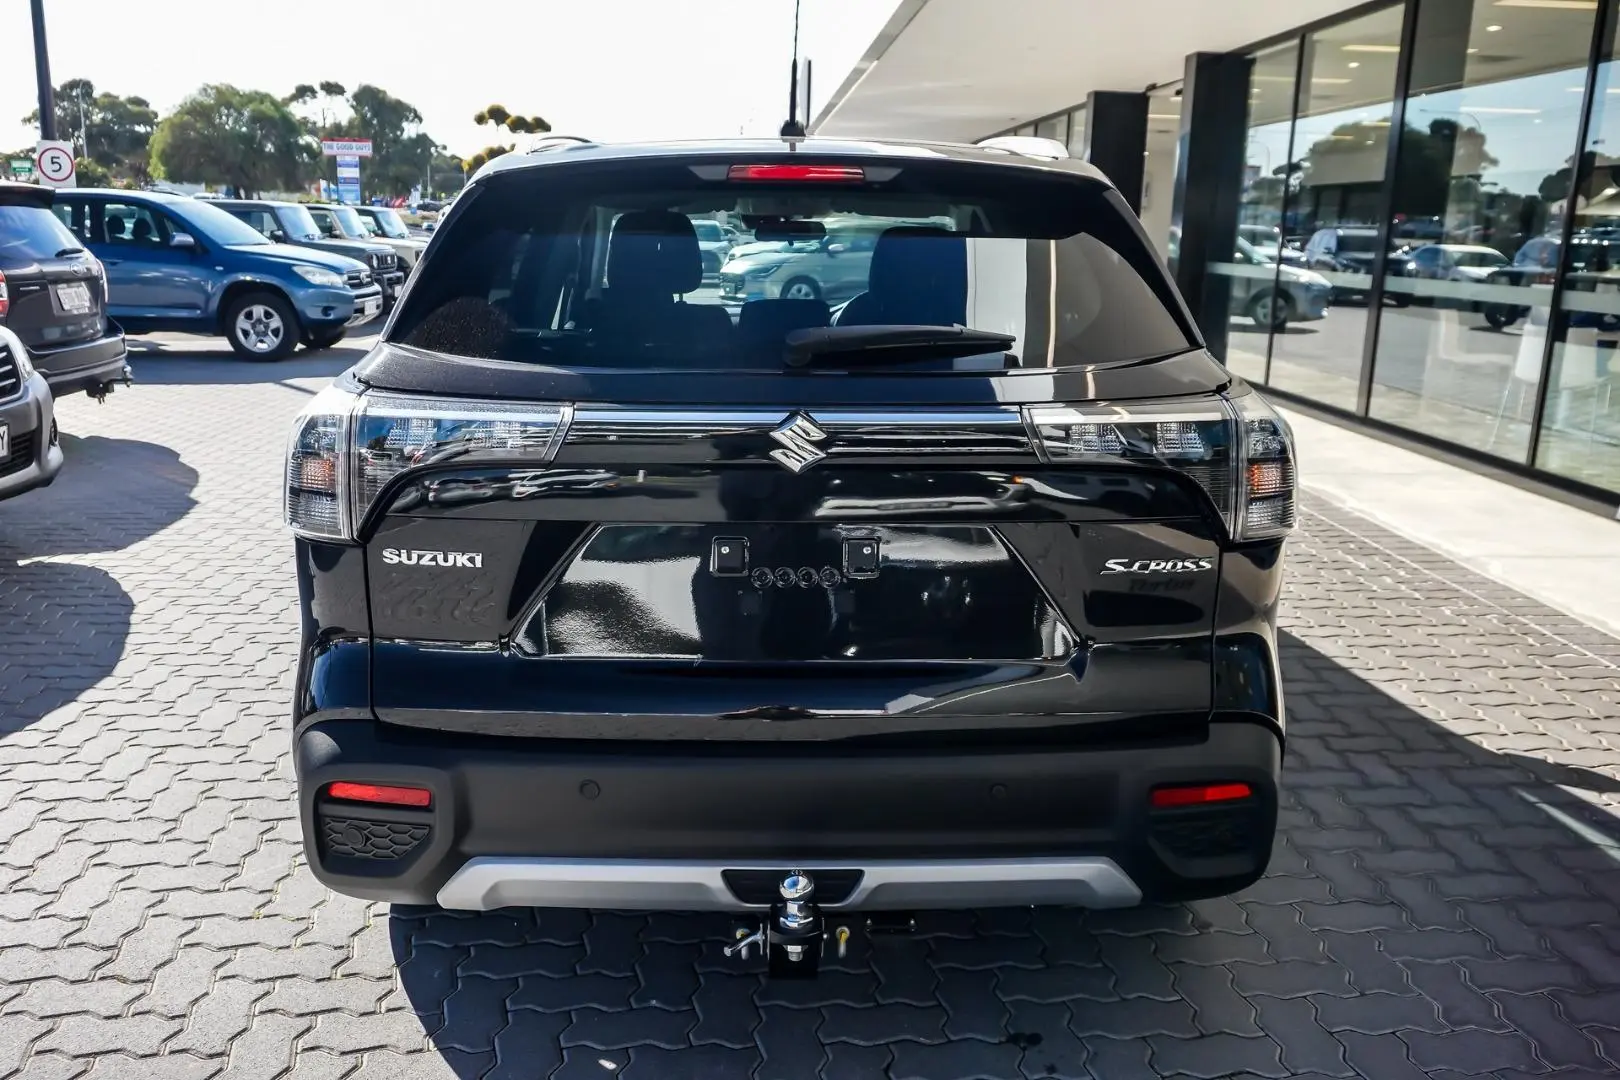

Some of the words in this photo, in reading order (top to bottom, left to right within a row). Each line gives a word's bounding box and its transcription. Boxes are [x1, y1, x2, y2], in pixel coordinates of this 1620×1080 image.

[336, 143, 353, 151] GOOD
[50, 156, 62, 173] 5
[382, 548, 483, 568] SUZUKI
